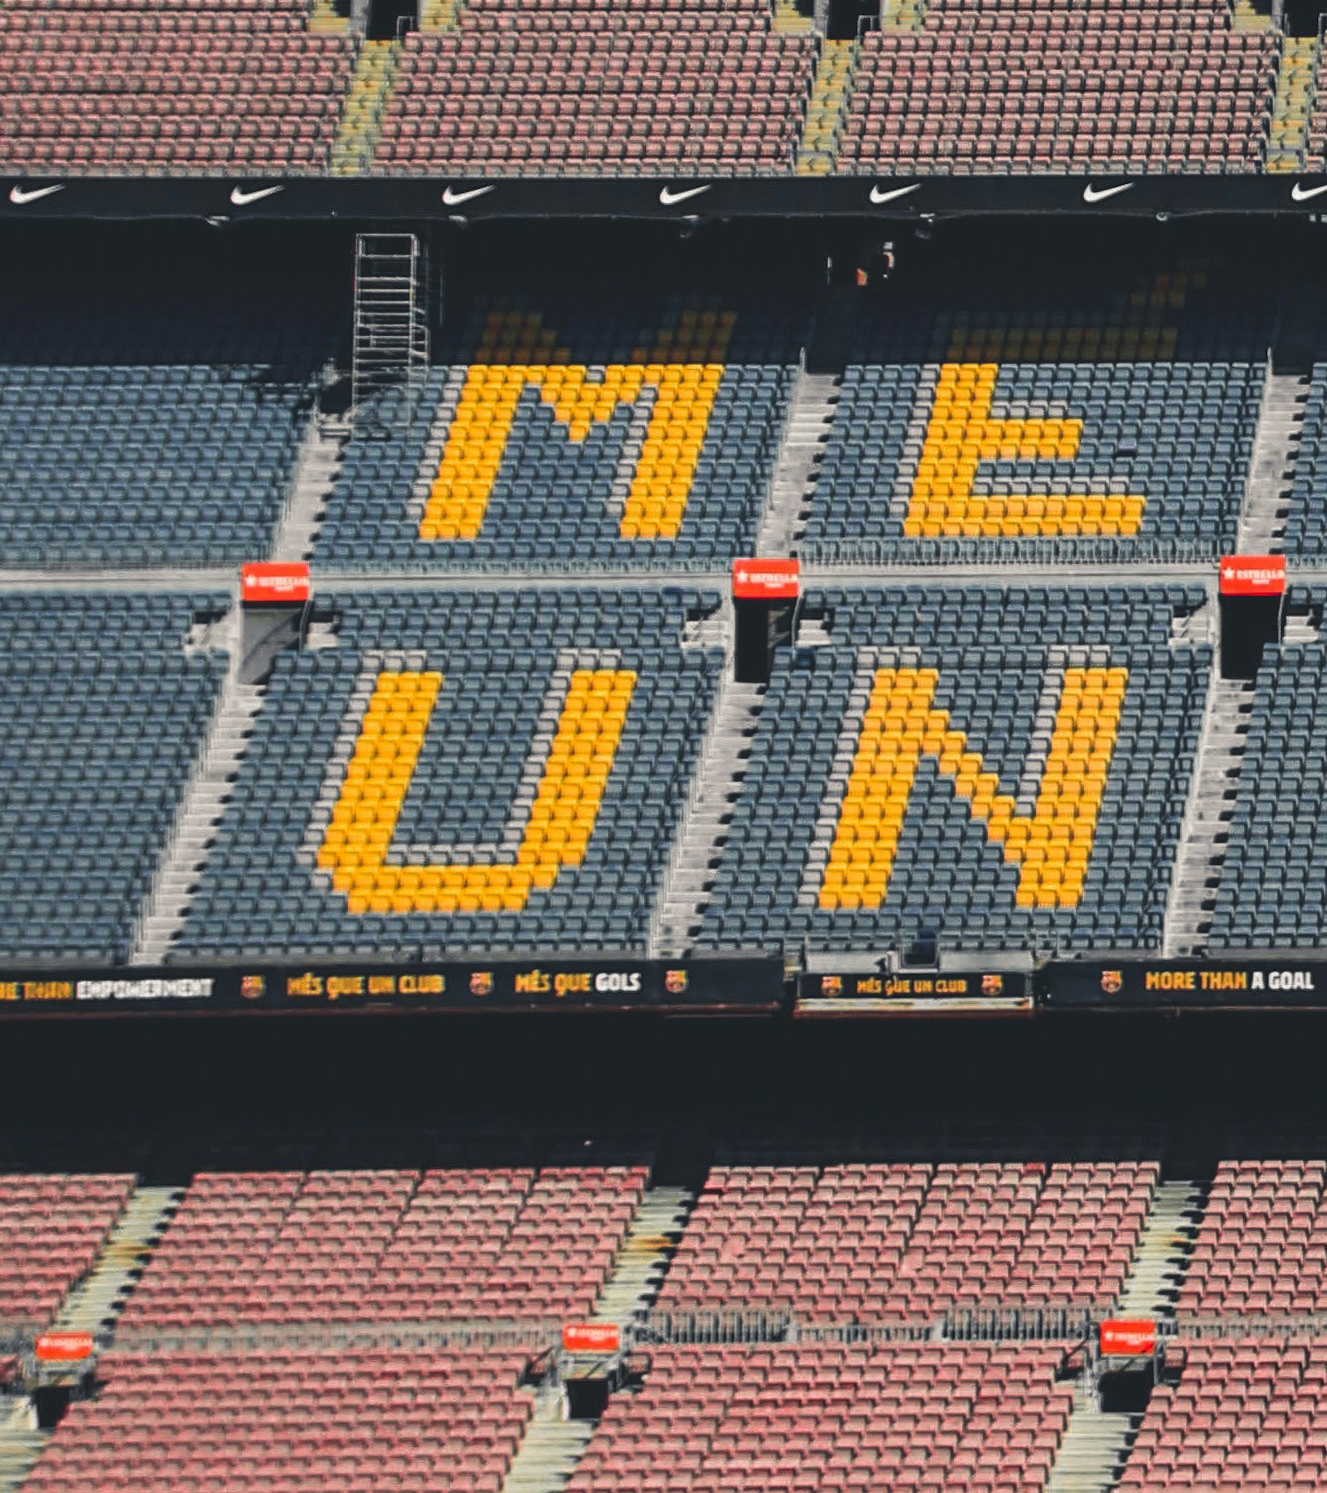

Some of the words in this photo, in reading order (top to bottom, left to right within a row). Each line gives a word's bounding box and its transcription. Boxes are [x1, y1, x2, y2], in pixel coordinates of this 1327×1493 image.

[318, 669, 1123, 911] UN
[399, 974, 445, 994] CLUB
[514, 969, 551, 993] MÉS
[554, 972, 591, 997] QUE
[595, 972, 641, 992] GOLS
[856, 977, 882, 994] MÉS
[914, 979, 933, 993] UN
[935, 979, 967, 994] CLUB
[1145, 970, 1196, 990] MORE
[1200, 970, 1247, 990] THAN
[1251, 971, 1265, 990] A
[1268, 971, 1314, 990] GOAL
